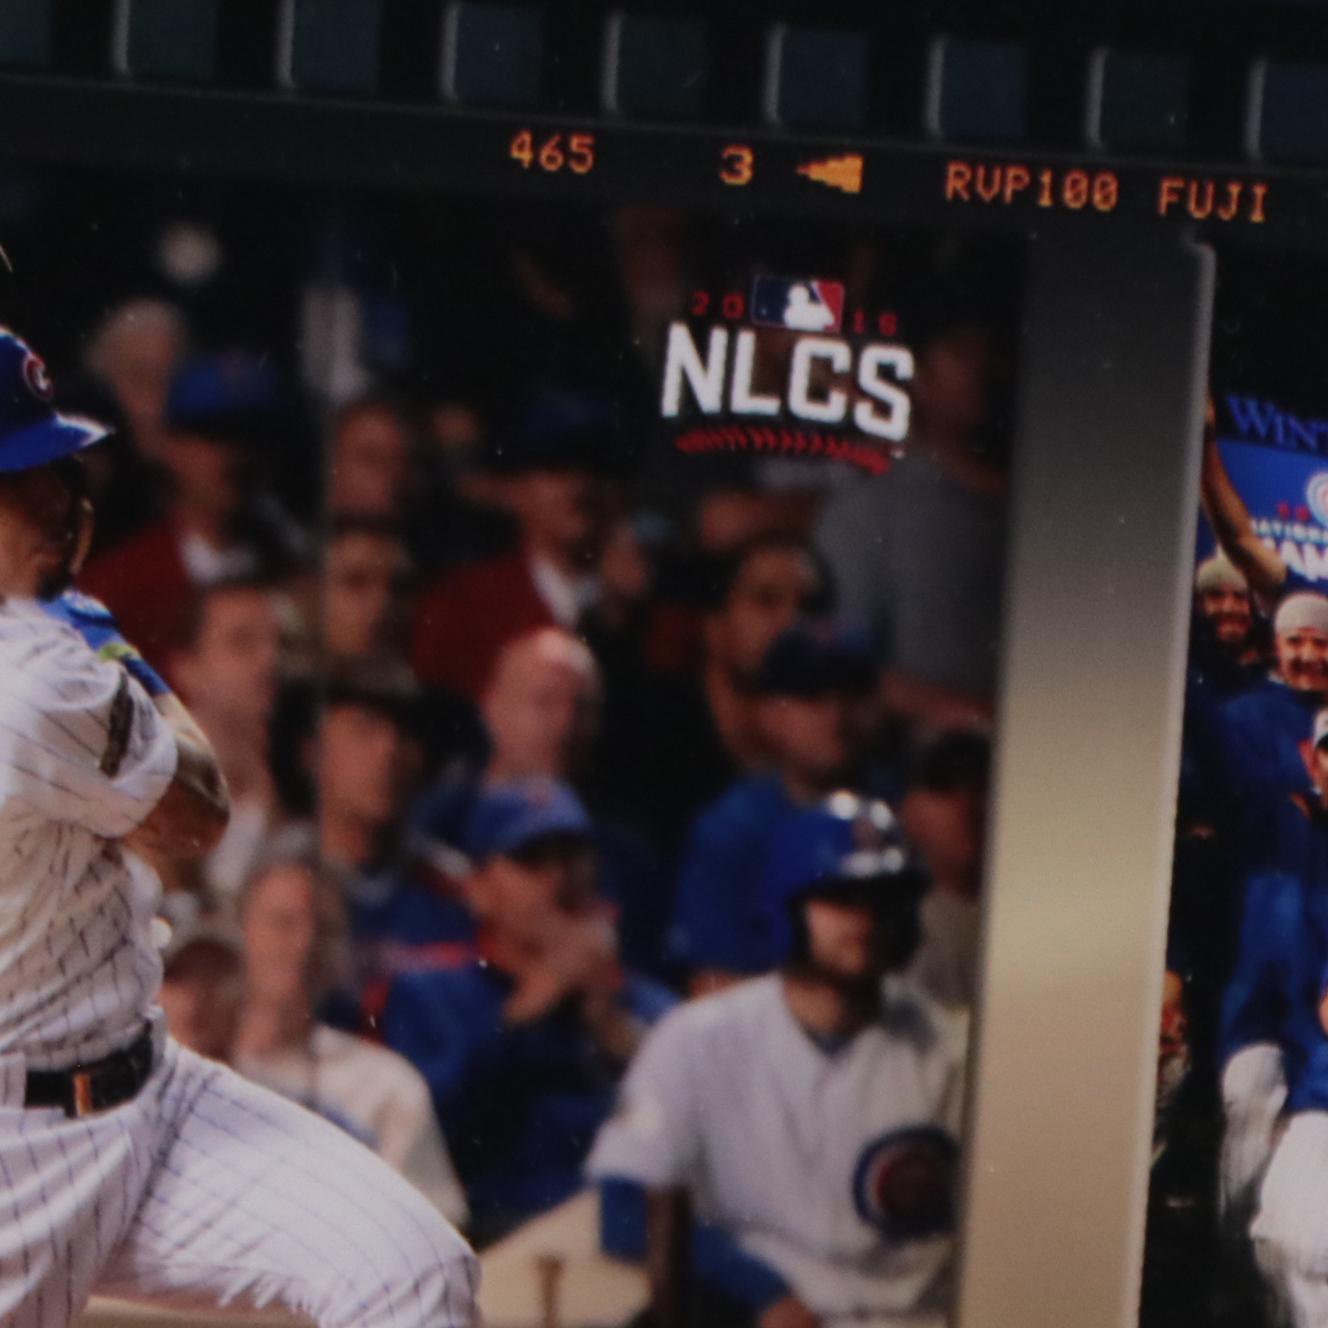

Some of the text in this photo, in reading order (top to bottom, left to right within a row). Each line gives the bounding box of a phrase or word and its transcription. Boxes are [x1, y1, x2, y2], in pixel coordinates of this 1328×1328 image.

[509, 129, 596, 175] 465
[719, 143, 755, 186] 3
[944, 160, 1120, 212] RVP100
[1157, 175, 1269, 223] FUJI
[661, 319, 914, 442] NLCS
